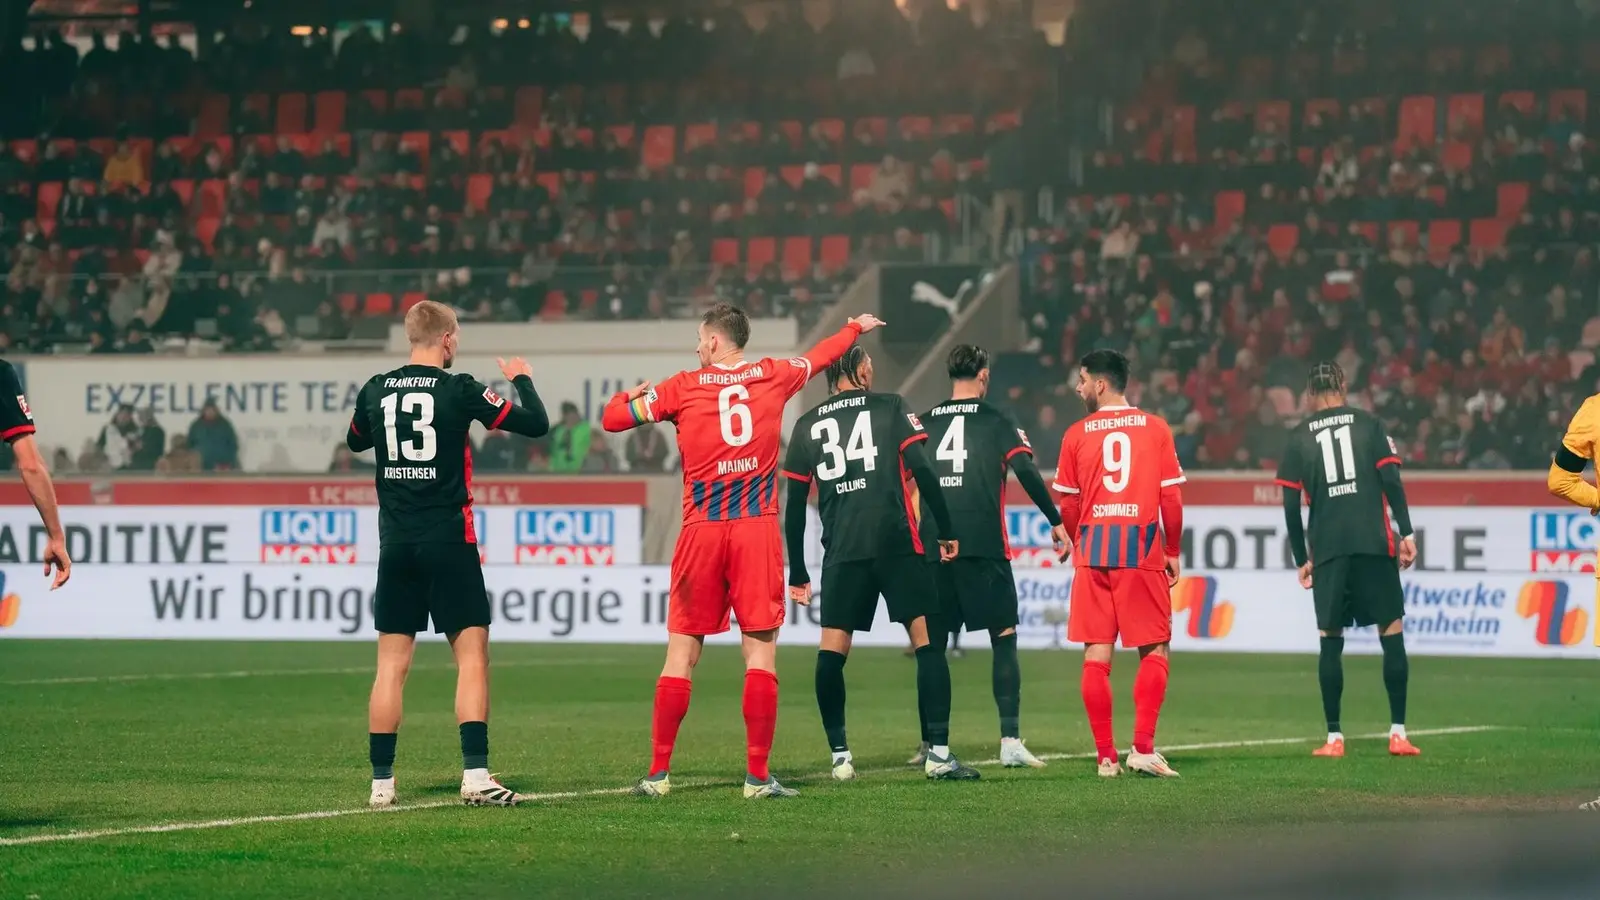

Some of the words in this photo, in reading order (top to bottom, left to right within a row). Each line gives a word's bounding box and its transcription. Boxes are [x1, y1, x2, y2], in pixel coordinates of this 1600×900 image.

[384, 377, 438, 388] FRANKFURT
[699, 366, 763, 385] HEIDENHEIM
[718, 384, 753, 447] 6
[818, 396, 866, 416] FRANKFURT
[931, 403, 979, 416] FRANKFURT
[380, 392, 437, 461] 13
[1084, 415, 1146, 433] HEIDENHEIM
[1309, 414, 1354, 431] FRANKFURT
[810, 410, 878, 481] 34
[936, 415, 968, 473] 4
[1315, 424, 1356, 483] 11
[384, 466, 437, 479] KRISTENSEN
[718, 456, 759, 475] MAINKA
[1102, 431, 1131, 493] 9
[939, 476, 963, 487] KOCH
[265, 512, 353, 543] LIQUI
[518, 512, 612, 544] LIQUI
[1018, 577, 1072, 601] Stad
[150, 574, 225, 620] Wir
[243, 573, 375, 634] bring
